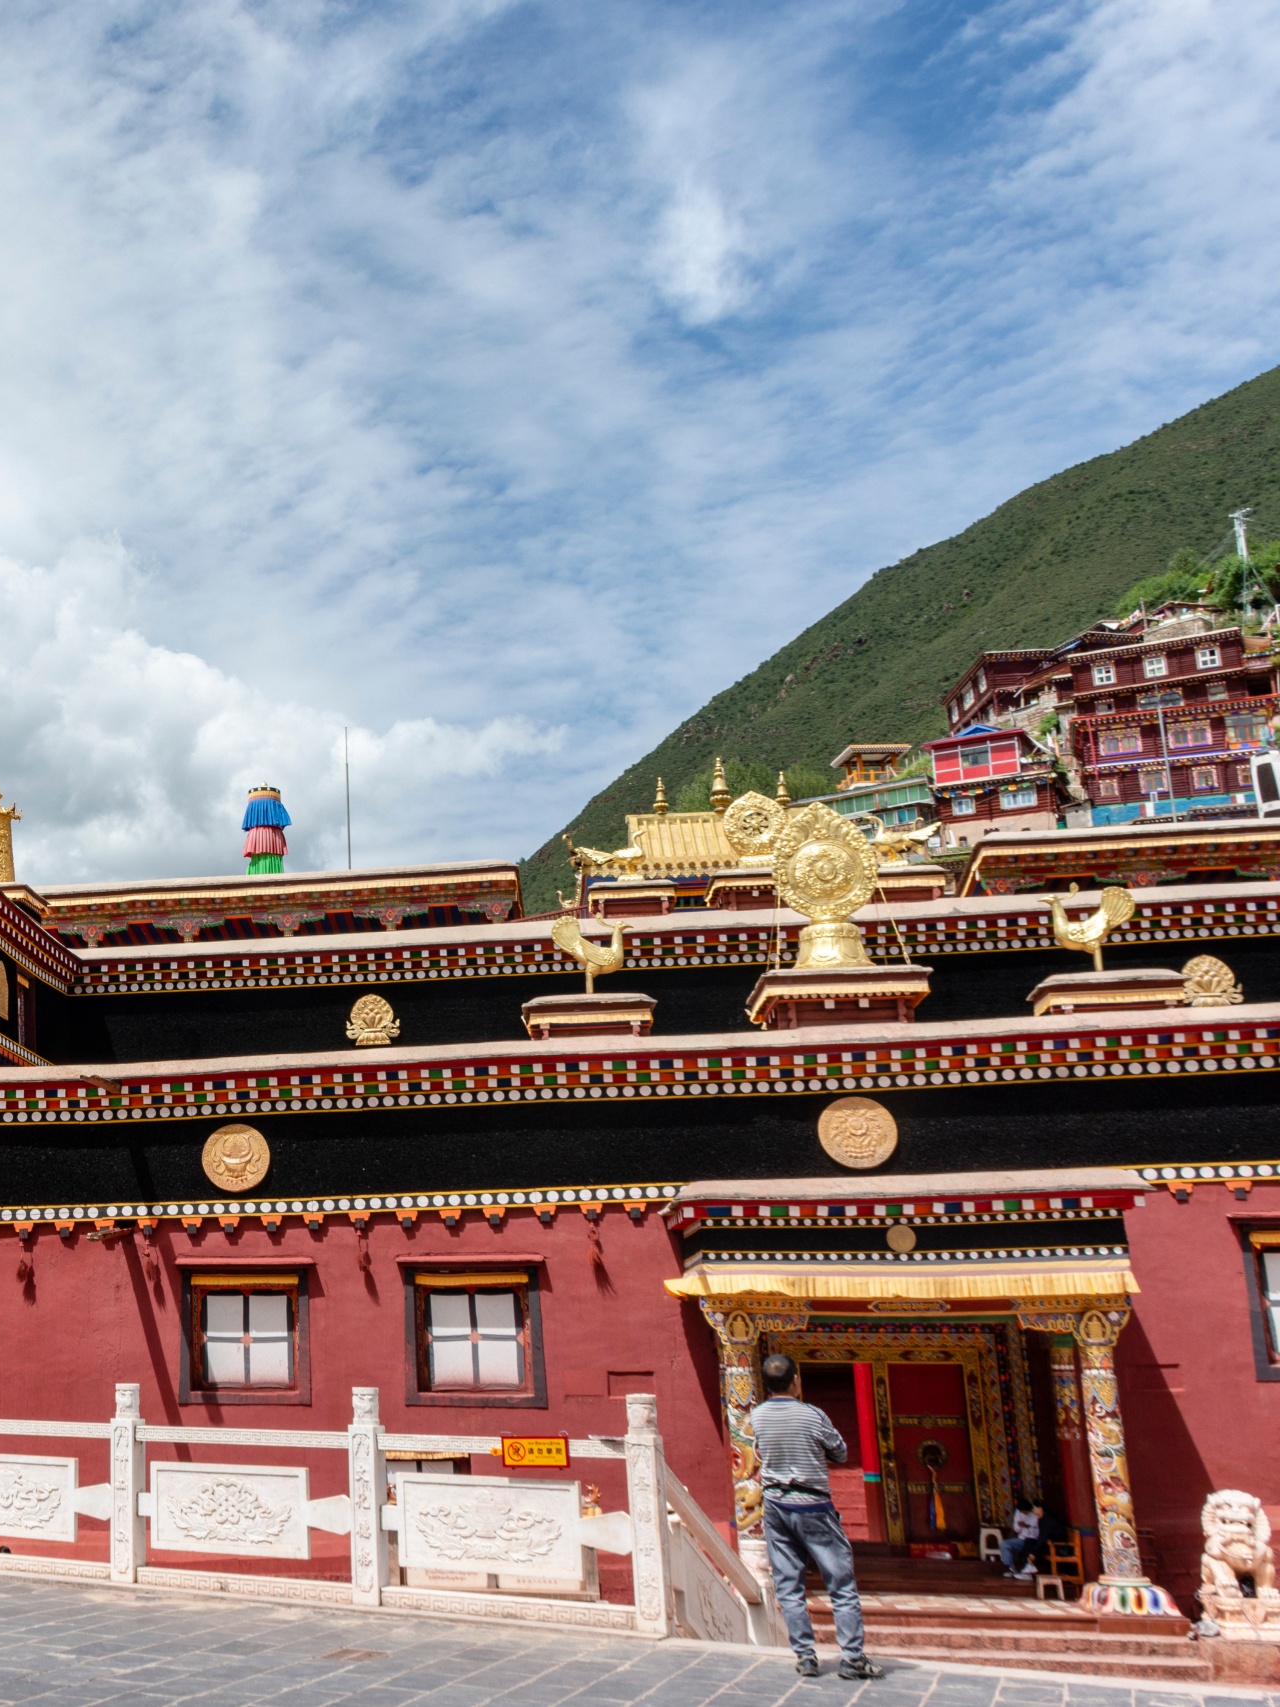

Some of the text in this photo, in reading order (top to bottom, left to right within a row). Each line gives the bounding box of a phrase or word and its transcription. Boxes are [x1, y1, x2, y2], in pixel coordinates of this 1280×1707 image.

[527, 1447, 563, 1455] 请勿攀爬
[355, 1465, 372, 1567] 文化德格
[633, 1475, 657, 1589] 圣洁甘孜
